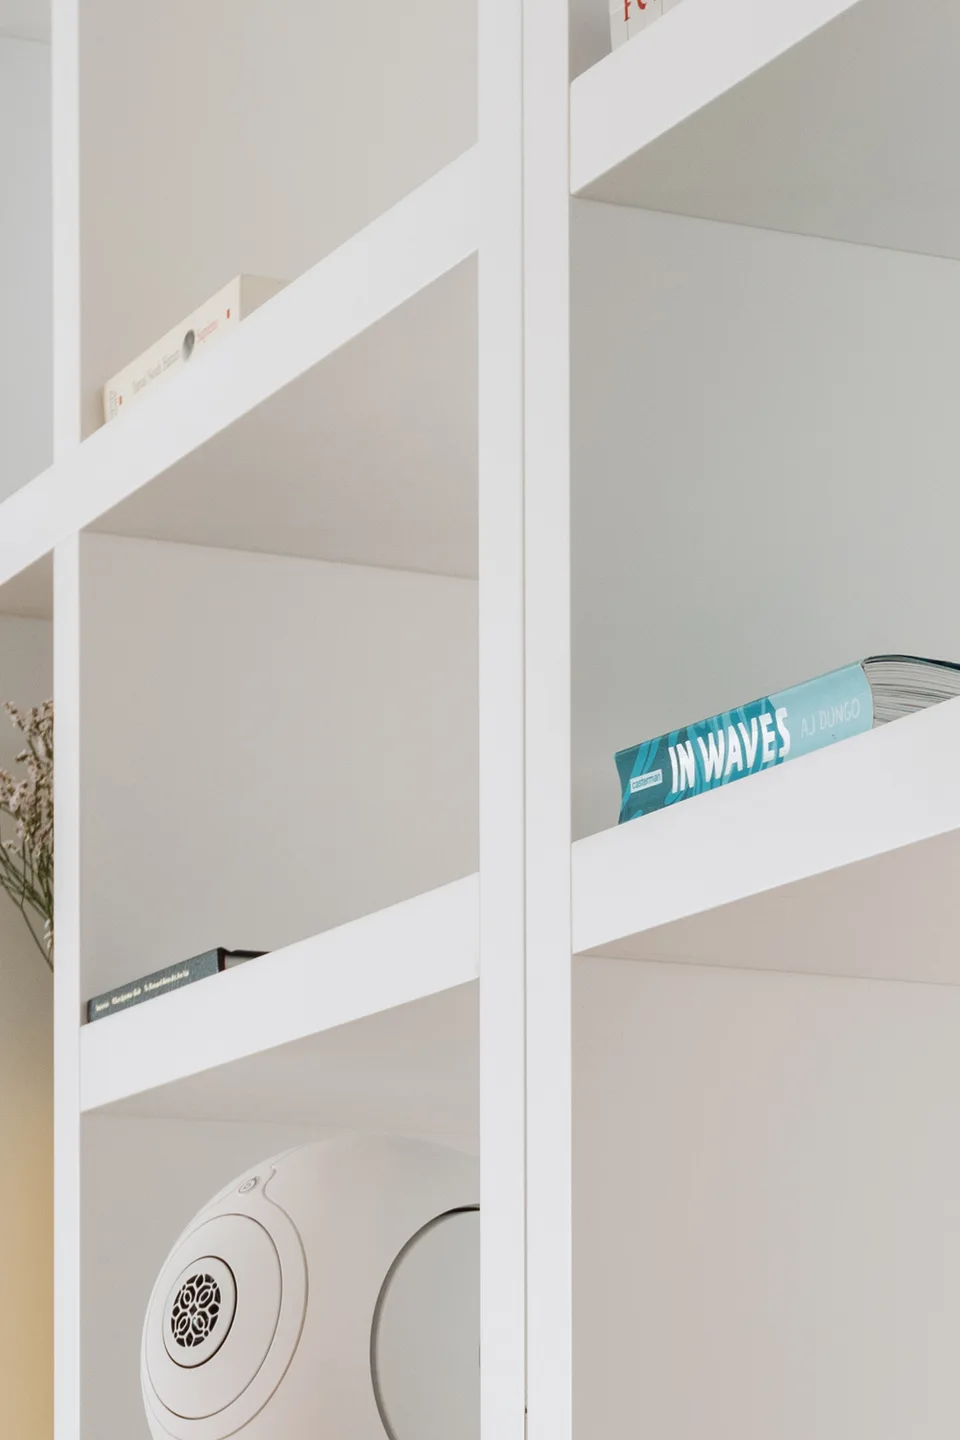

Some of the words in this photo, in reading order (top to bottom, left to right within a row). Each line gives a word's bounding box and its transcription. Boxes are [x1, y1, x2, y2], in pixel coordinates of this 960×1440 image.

[801, 716, 816, 738] AJ
[819, 697, 861, 730] DUNGO
[668, 741, 696, 794] IN
[697, 706, 791, 783] WAVES
